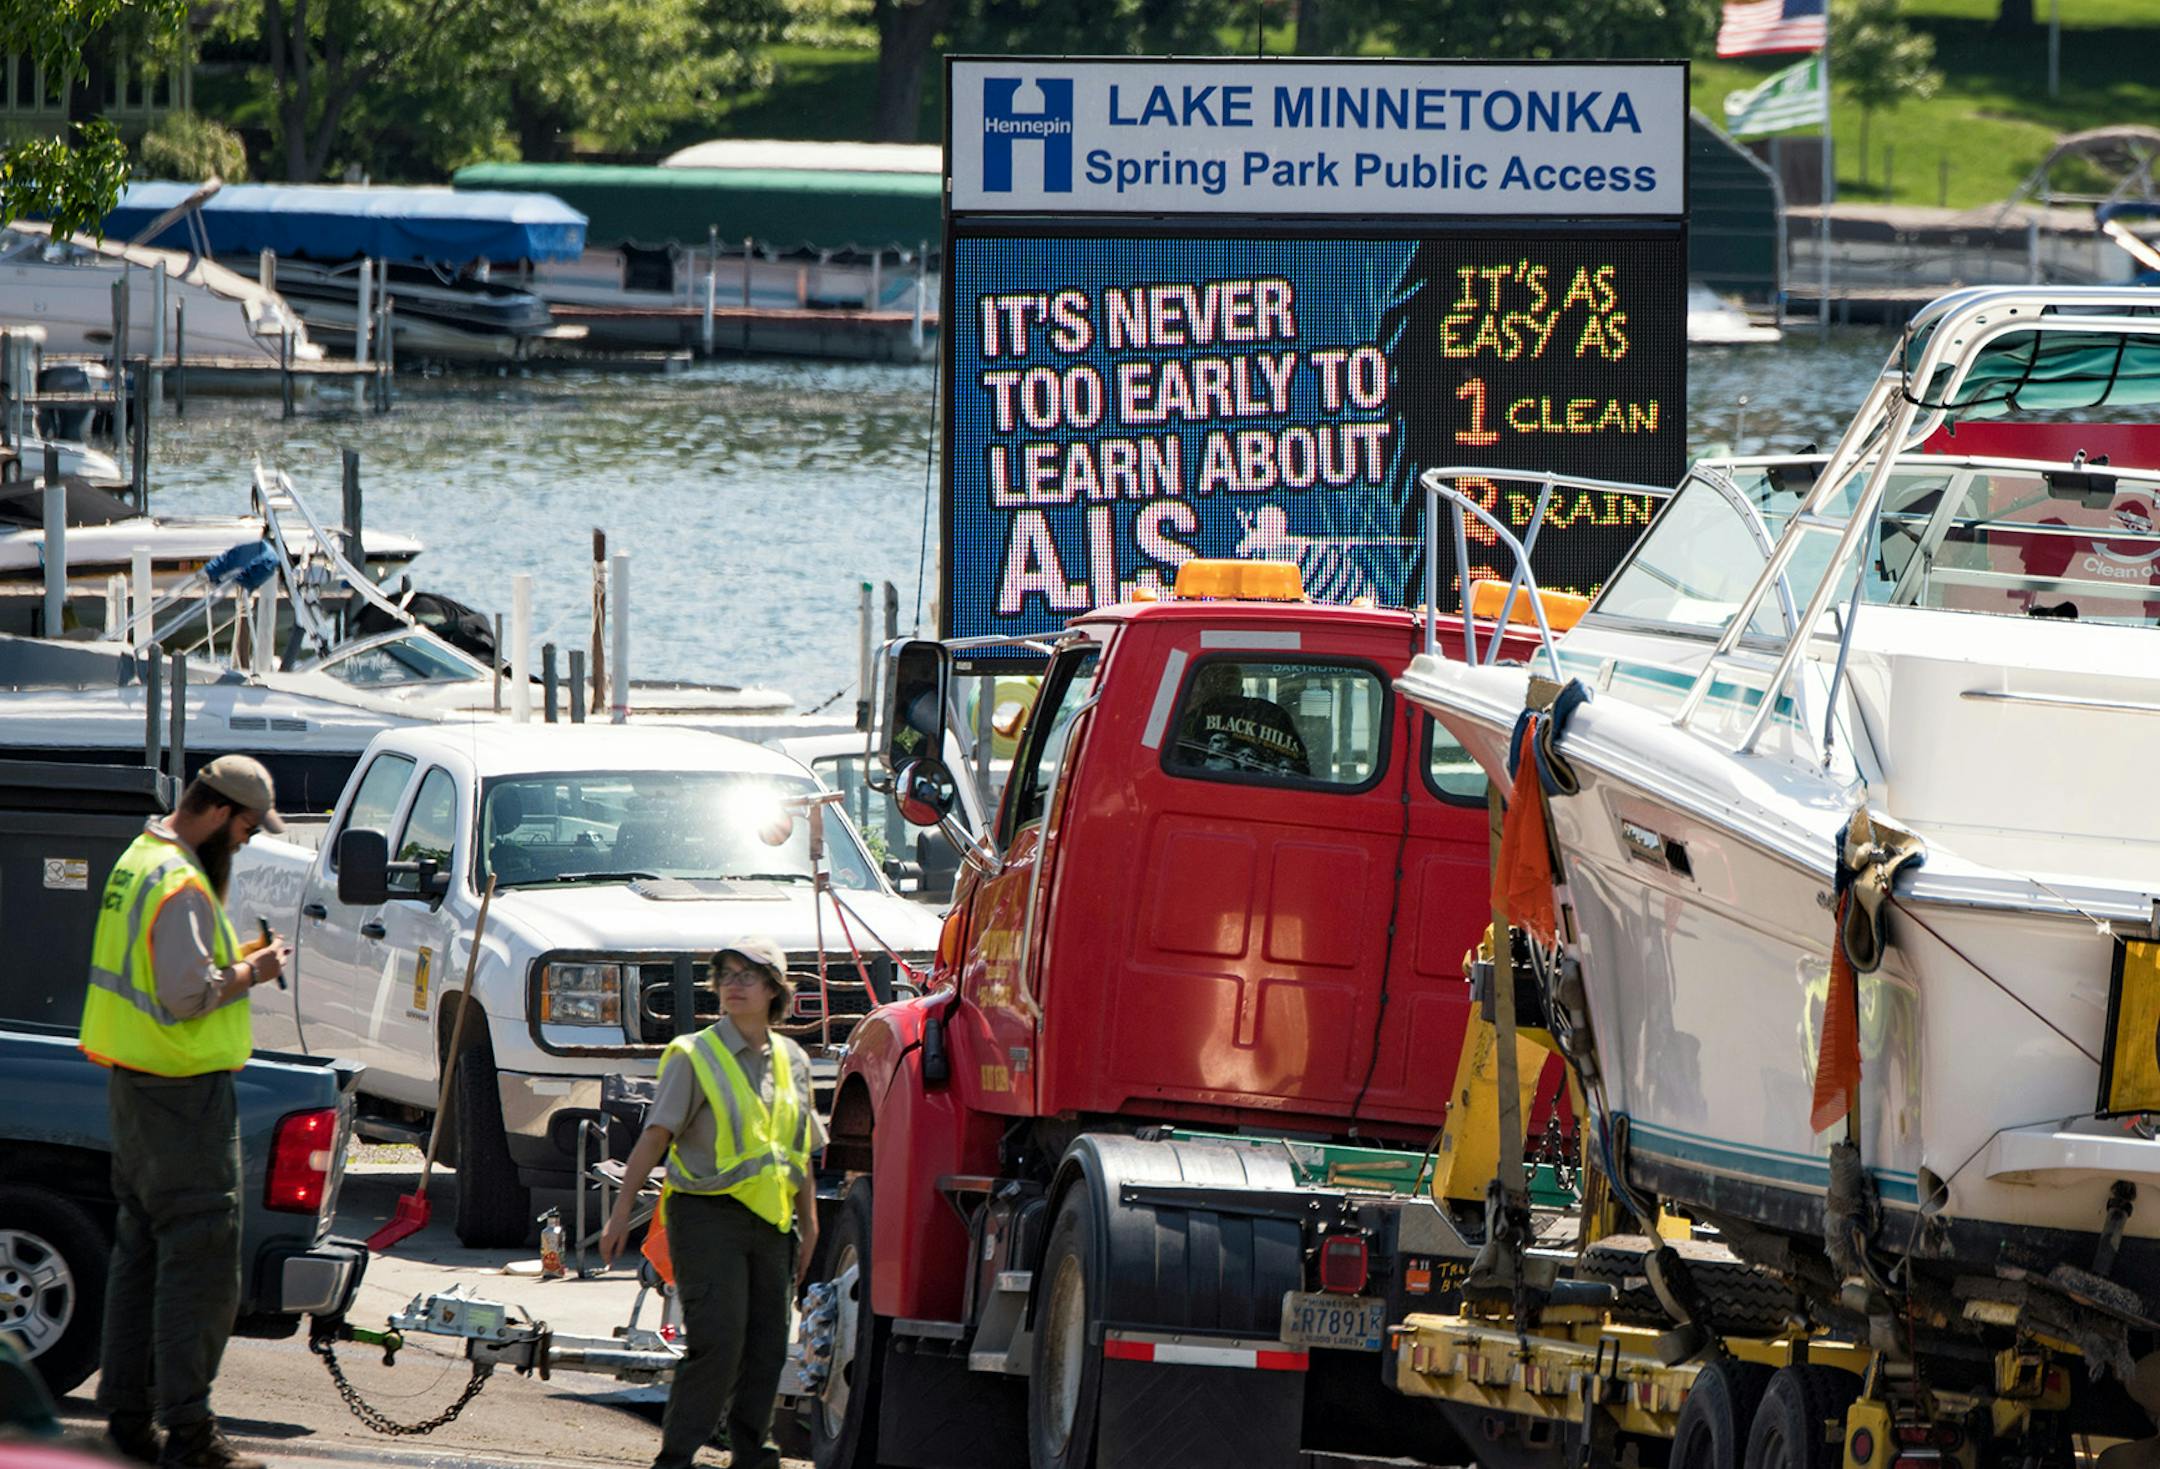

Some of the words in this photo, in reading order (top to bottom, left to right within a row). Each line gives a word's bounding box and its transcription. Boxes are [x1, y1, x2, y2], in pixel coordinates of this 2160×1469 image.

[984, 115, 1072, 138] Hennepin
[1108, 84, 1254, 128] LAKE
[1273, 86, 1643, 134] MINNETONKA
[1085, 149, 1227, 194] Spring
[1243, 151, 1340, 187] Park
[1354, 153, 1488, 190] Public
[1499, 155, 1657, 192] Access
[1452, 257, 1549, 313] IT'S
[1563, 264, 1618, 314] AS
[980, 291, 1093, 357] IT'S
[1105, 278, 1295, 350] NEVER
[1440, 311, 1561, 362] EASY
[1575, 311, 1630, 362] AS
[983, 365, 1102, 432] TOO
[1118, 351, 1296, 426] EARLY
[1311, 346, 1387, 411] TO
[1454, 376, 1500, 447] 1
[1506, 395, 1660, 434] CLEAN
[991, 434, 1182, 508] LEARN
[1199, 422, 1390, 494] ABOUT
[2083, 556, 2138, 578] Clean
[1205, 715, 1258, 737] BLACK
